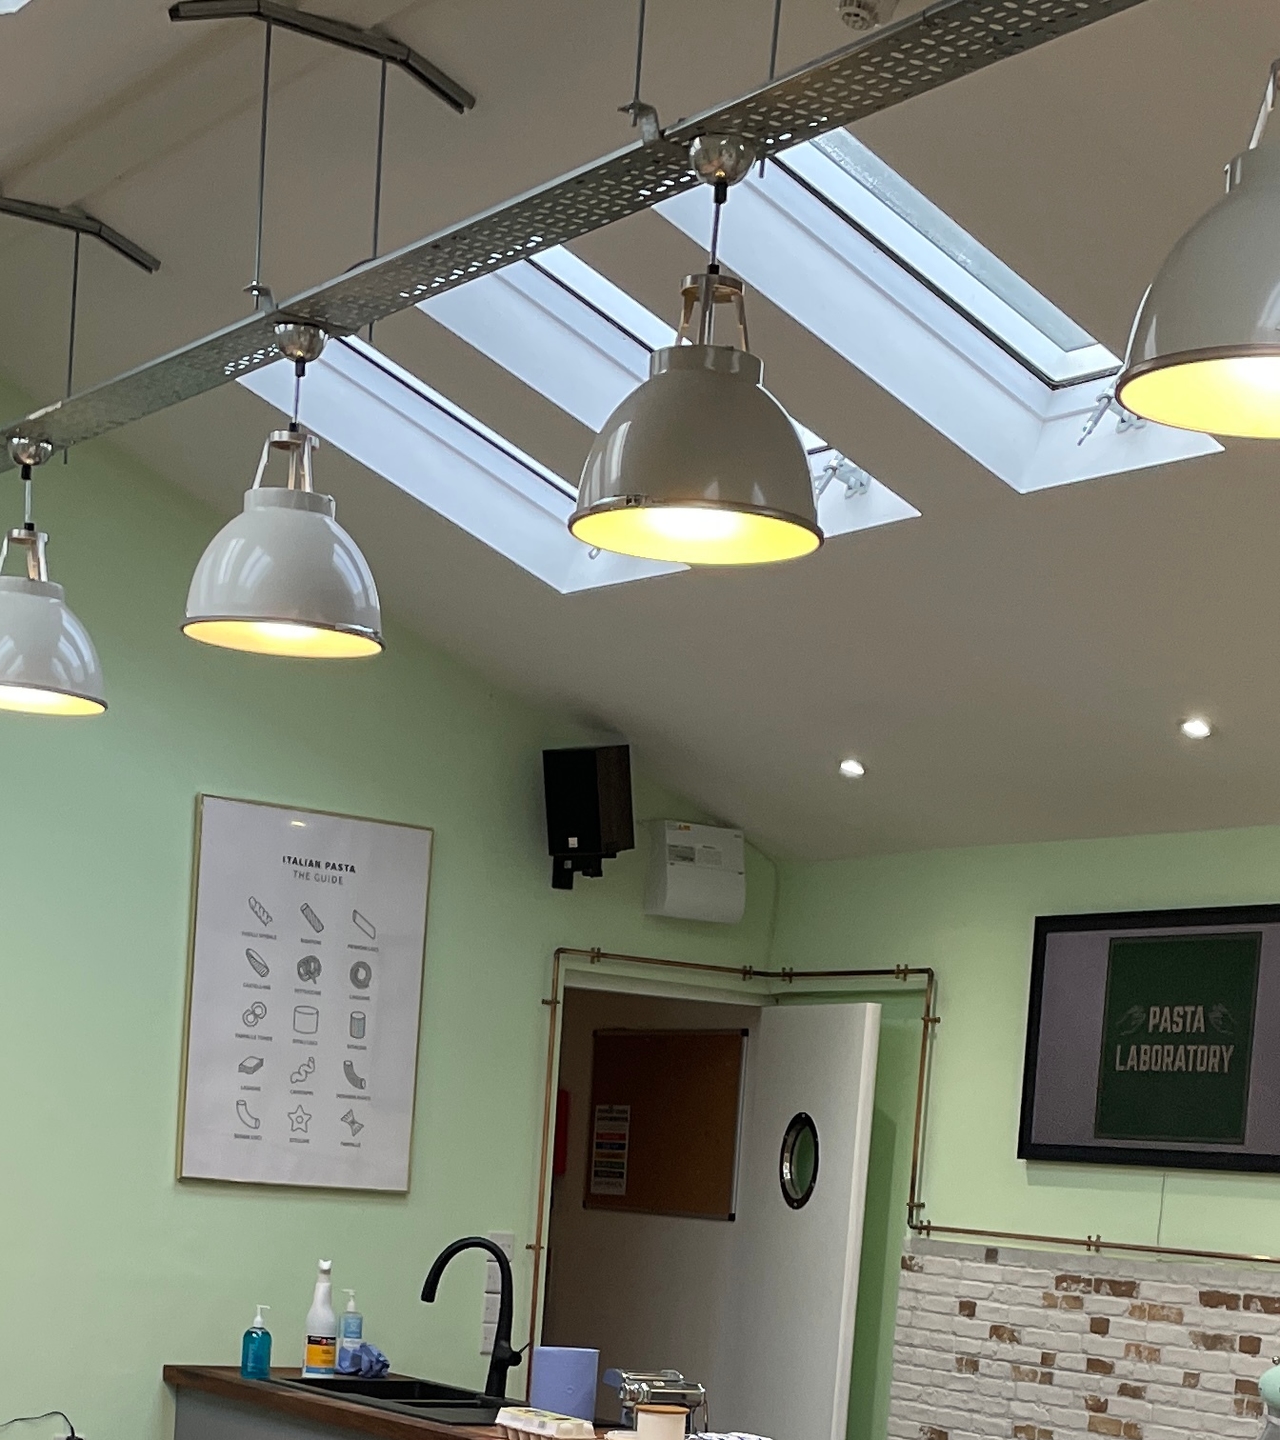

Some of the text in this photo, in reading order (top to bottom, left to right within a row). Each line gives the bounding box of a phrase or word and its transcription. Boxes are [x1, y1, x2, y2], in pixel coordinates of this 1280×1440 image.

[282, 855, 356, 874] ITALIAN PASTA
[293, 869, 344, 885] THE GUIDE
[1147, 1005, 1206, 1034] PASTA
[1115, 1044, 1235, 1073] LABORATORY
